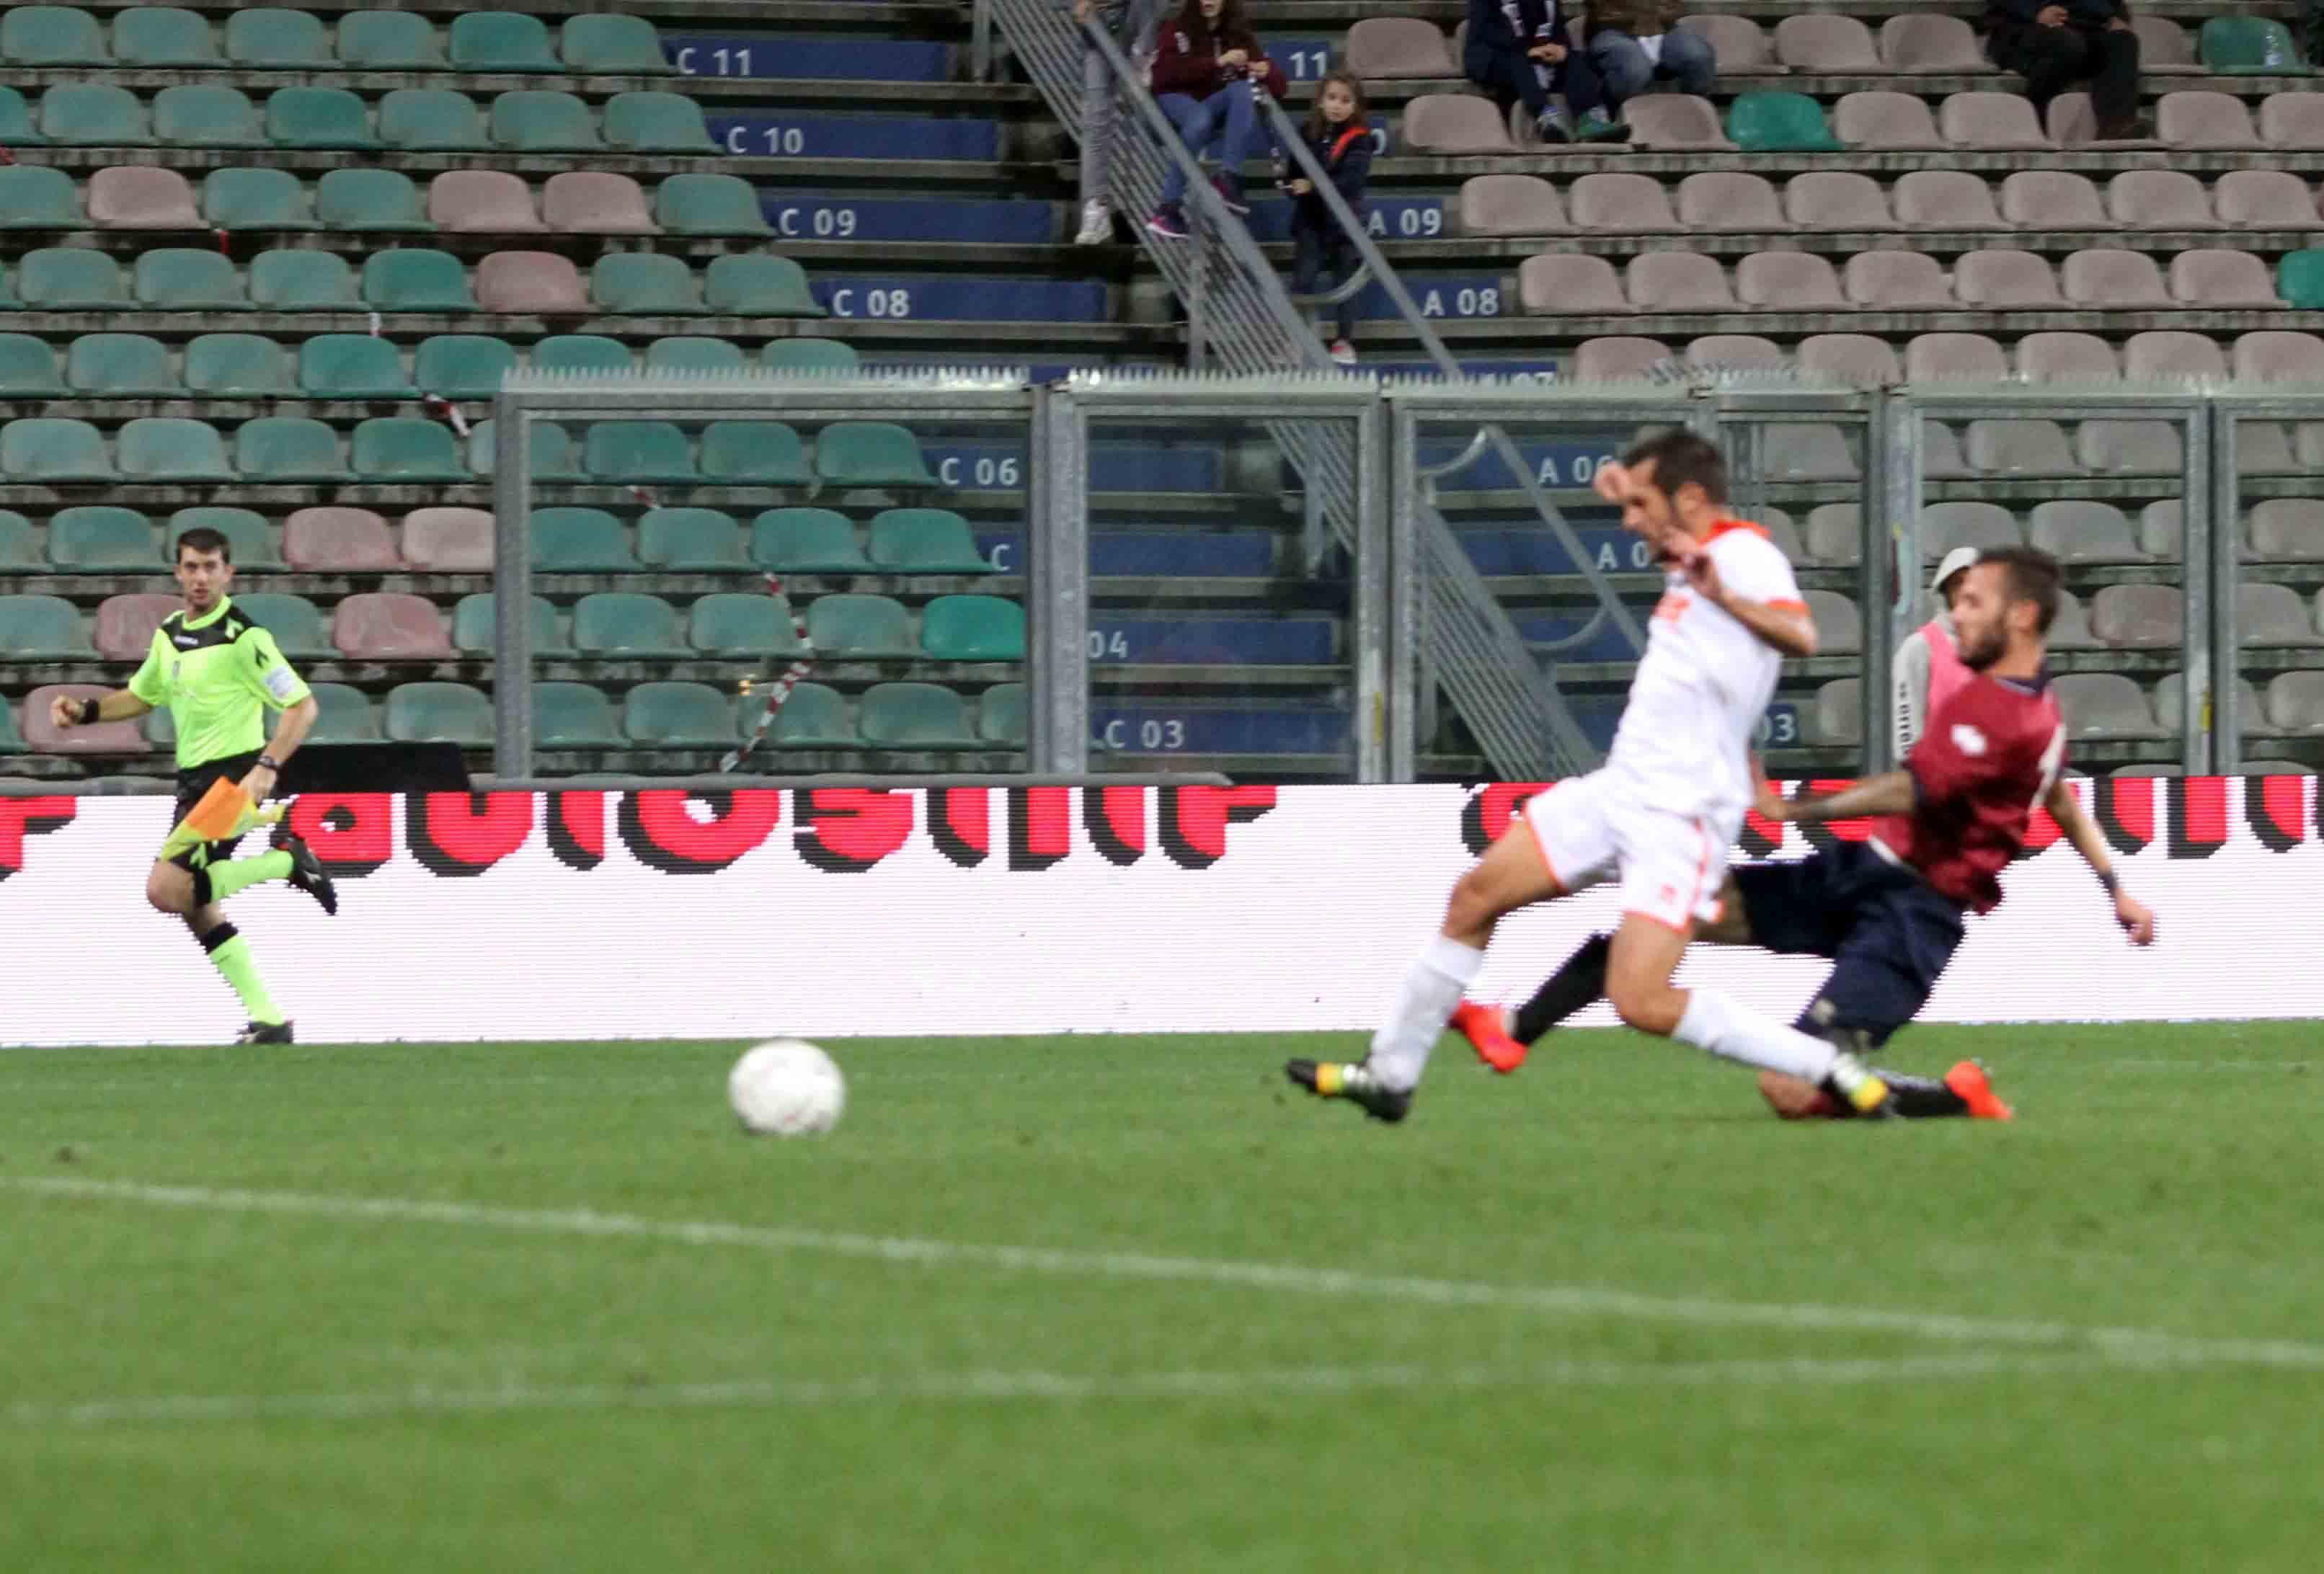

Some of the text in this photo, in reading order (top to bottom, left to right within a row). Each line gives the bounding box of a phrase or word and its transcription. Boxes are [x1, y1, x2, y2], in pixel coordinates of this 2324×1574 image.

[677, 48, 750, 76] C 11
[1289, 51, 1327, 78] 11
[727, 126, 804, 154] C 10
[780, 208, 856, 236] C 09
[1400, 208, 1442, 236] 09
[833, 289, 910, 317] C 08
[1423, 288, 1498, 316] A 08
[940, 458, 1019, 485] C 06
[1538, 457, 1560, 484] A
[992, 543, 1010, 572] C
[1597, 541, 1619, 569] A
[1105, 720, 1184, 749] C 03
